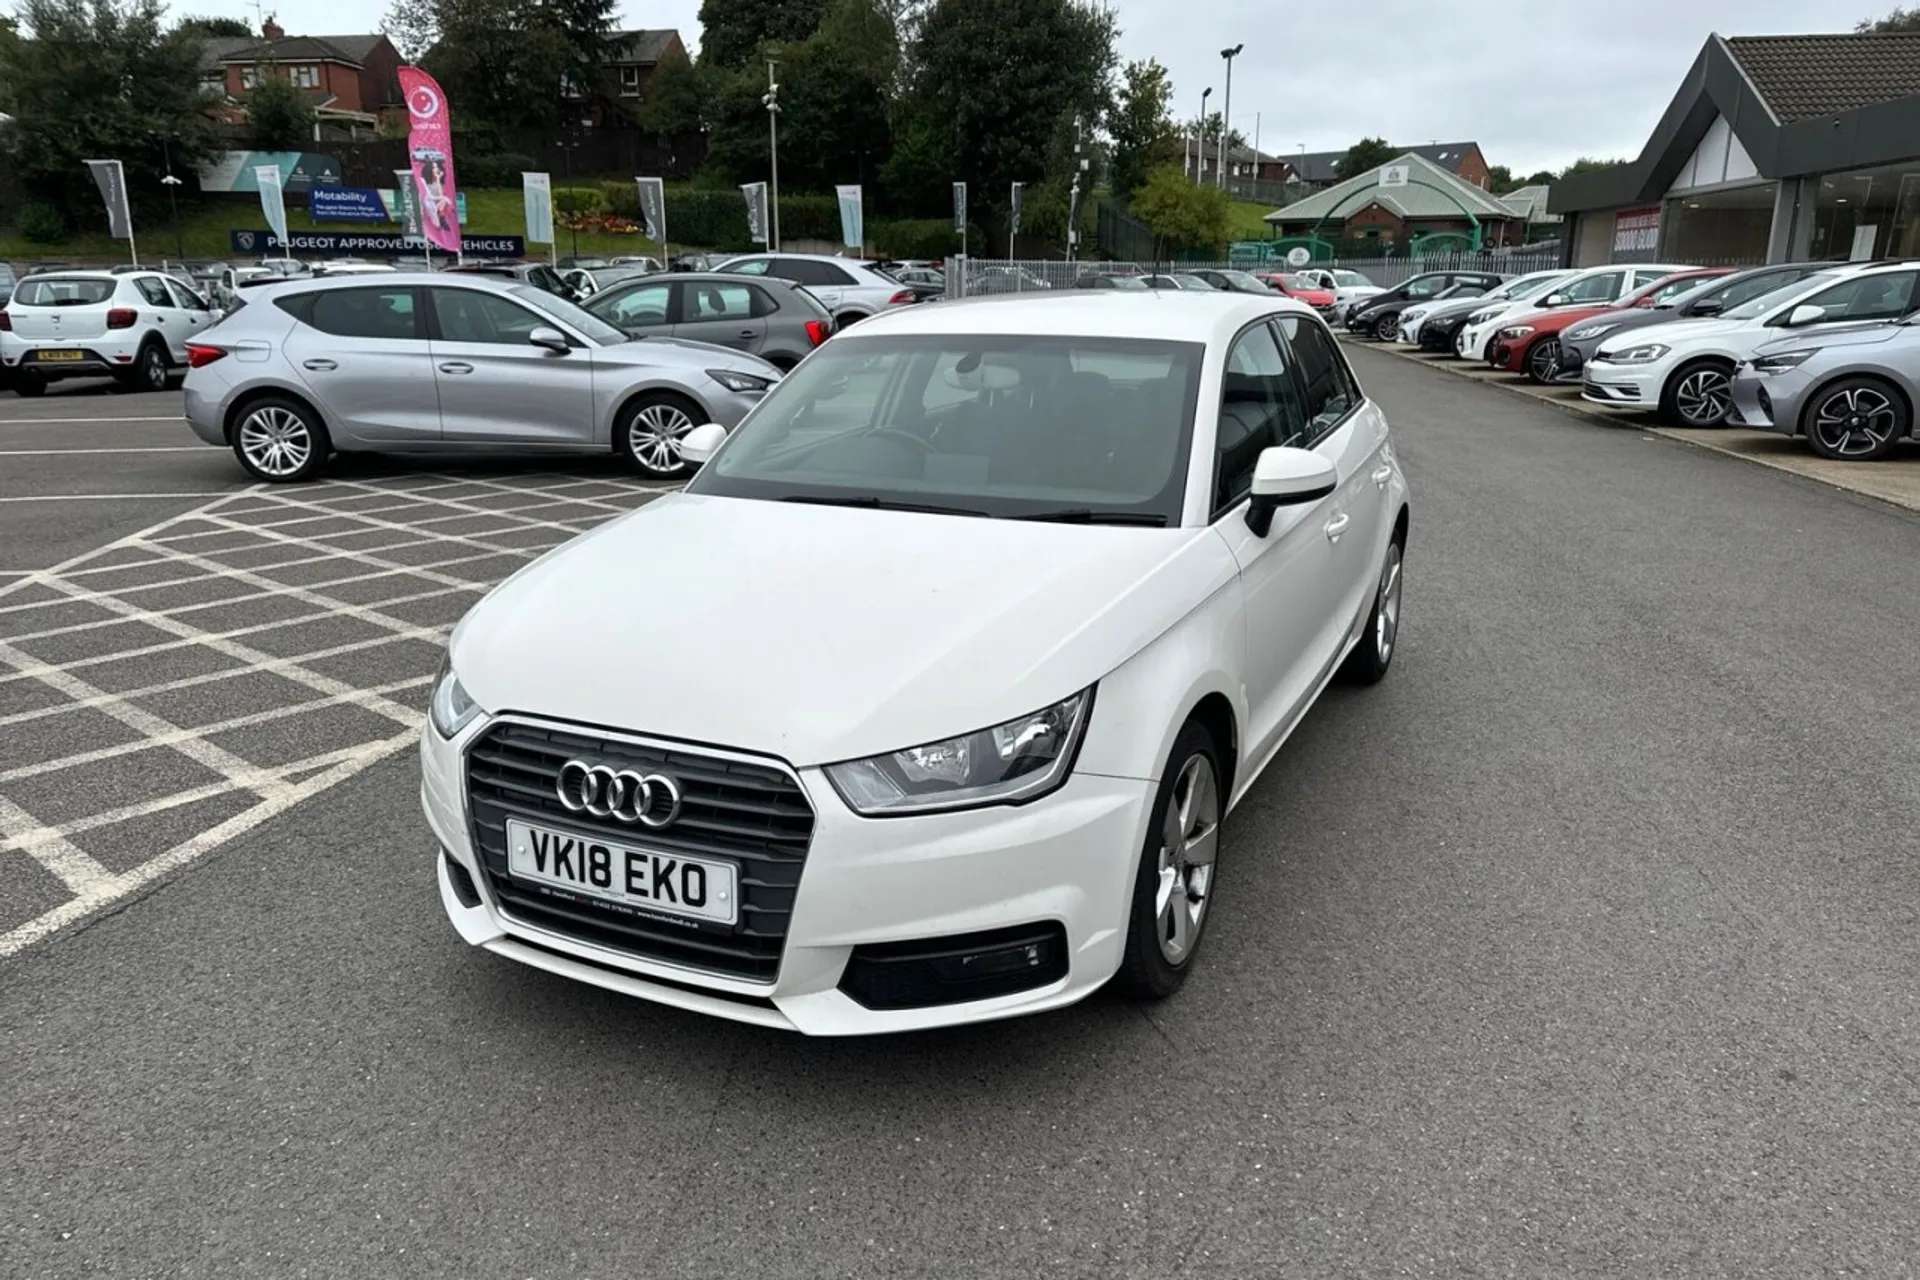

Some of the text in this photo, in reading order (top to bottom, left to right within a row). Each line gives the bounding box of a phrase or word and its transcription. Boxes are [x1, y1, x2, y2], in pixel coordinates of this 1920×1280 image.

[314, 190, 367, 203] Motability
[339, 238, 414, 249] APPROVED
[530, 830, 706, 907] VK18 EKO
